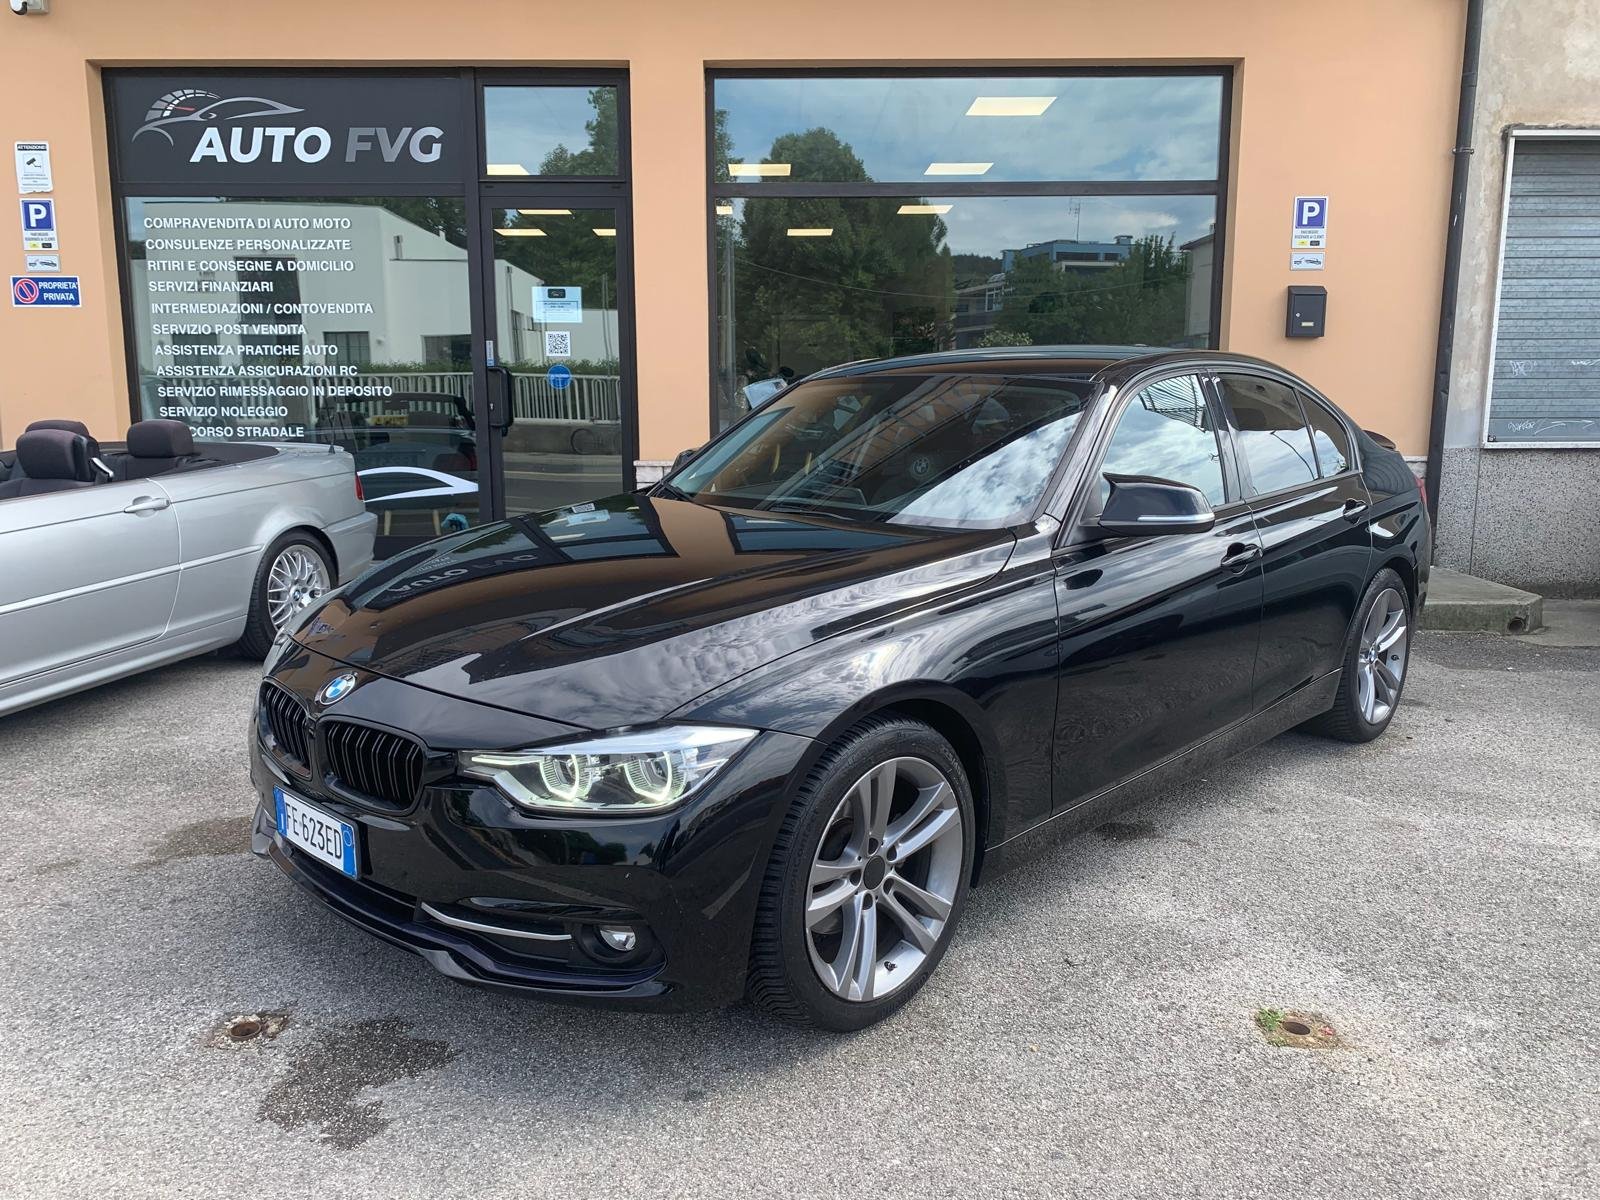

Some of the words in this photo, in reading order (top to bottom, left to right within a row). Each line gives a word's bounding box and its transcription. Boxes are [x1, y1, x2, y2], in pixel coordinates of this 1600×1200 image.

[189, 126, 332, 163] AUTO
[345, 126, 444, 163] FVG
[28, 203, 47, 228] P
[1301, 201, 1320, 225] P
[143, 217, 255, 229] COMPRAVENDITA
[257, 218, 270, 229] DI
[273, 218, 310, 229] AUTO
[312, 218, 351, 229] MOTO
[145, 239, 234, 250] CONSULENZE
[237, 239, 352, 250] PERSONALIZZATE
[147, 260, 184, 271] RITIRI
[188, 260, 196, 271] E
[199, 260, 272, 271] CONSEGNE
[275, 260, 285, 271] A
[287, 260, 354, 271] DOMICILIO
[148, 281, 199, 292] SERVIZI
[201, 281, 273, 292] FINANZIARI
[43, 292, 75, 301] PRIVATA
[151, 303, 263, 314] INTERMEDIAZIONI
[266, 303, 271, 314] /
[273, 303, 374, 314] CONTOVENDITA
[152, 324, 212, 335] SERVIZIO
[215, 324, 249, 335] POST
[252, 324, 306, 335] VENDITA
[154, 344, 235, 355] ASSISTENZA
[237, 345, 300, 355] PRATICHE
[303, 345, 338, 355] AUTO
[156, 365, 236, 376] ASSISTENZA
[238, 365, 336, 376] ASSICURAZIONI
[339, 365, 358, 376] RC
[157, 386, 216, 397] SERVIZIO
[219, 386, 309, 397] RIMESSAGGIO
[312, 386, 325, 396] IN
[328, 386, 393, 397] DEPOSITO
[159, 406, 218, 417] SERVIZIO
[221, 406, 289, 417] NOLEGGIO
[189, 426, 234, 437] CORSO
[236, 426, 305, 437] STRADALE
